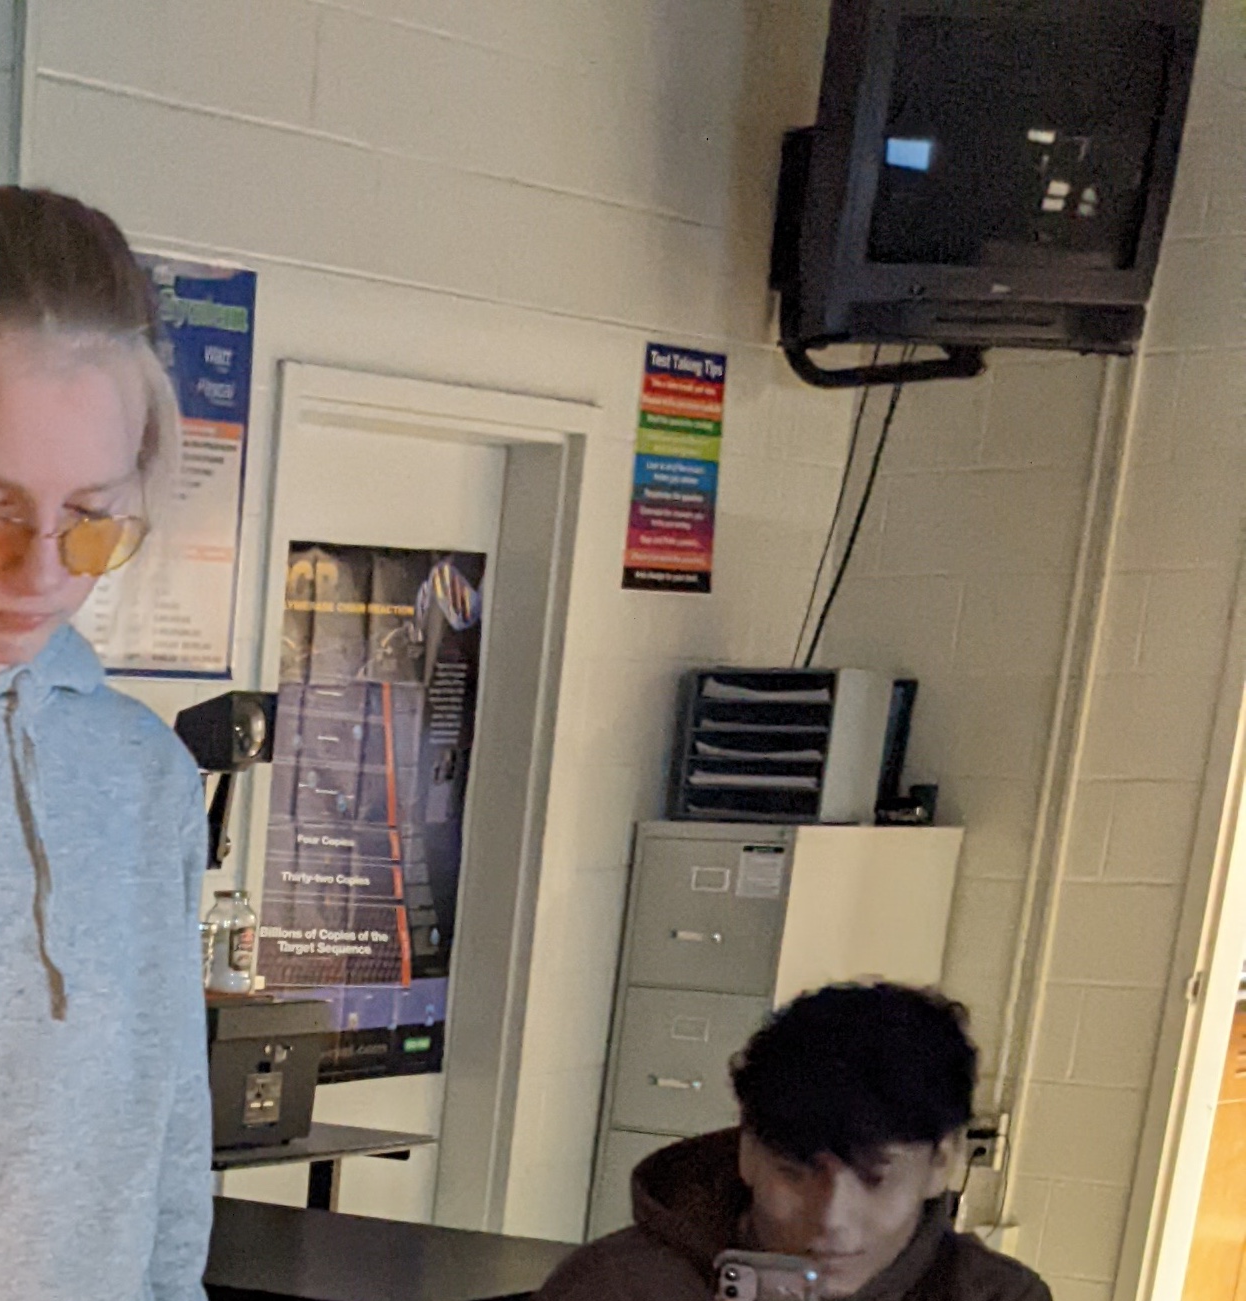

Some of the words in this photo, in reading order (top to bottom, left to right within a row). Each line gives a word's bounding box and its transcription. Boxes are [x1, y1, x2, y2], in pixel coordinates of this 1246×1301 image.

[297, 833, 321, 845] Four
[321, 834, 356, 847] Copies
[281, 871, 334, 885] Thirty-two
[335, 873, 371, 887] Copies
[259, 924, 303, 940] Billions
[304, 927, 317, 940] of
[318, 928, 357, 942] Copies
[357, 929, 369, 942] of
[370, 929, 390, 943] the
[277, 940, 316, 956] Target
[316, 942, 373, 957] Sequence
